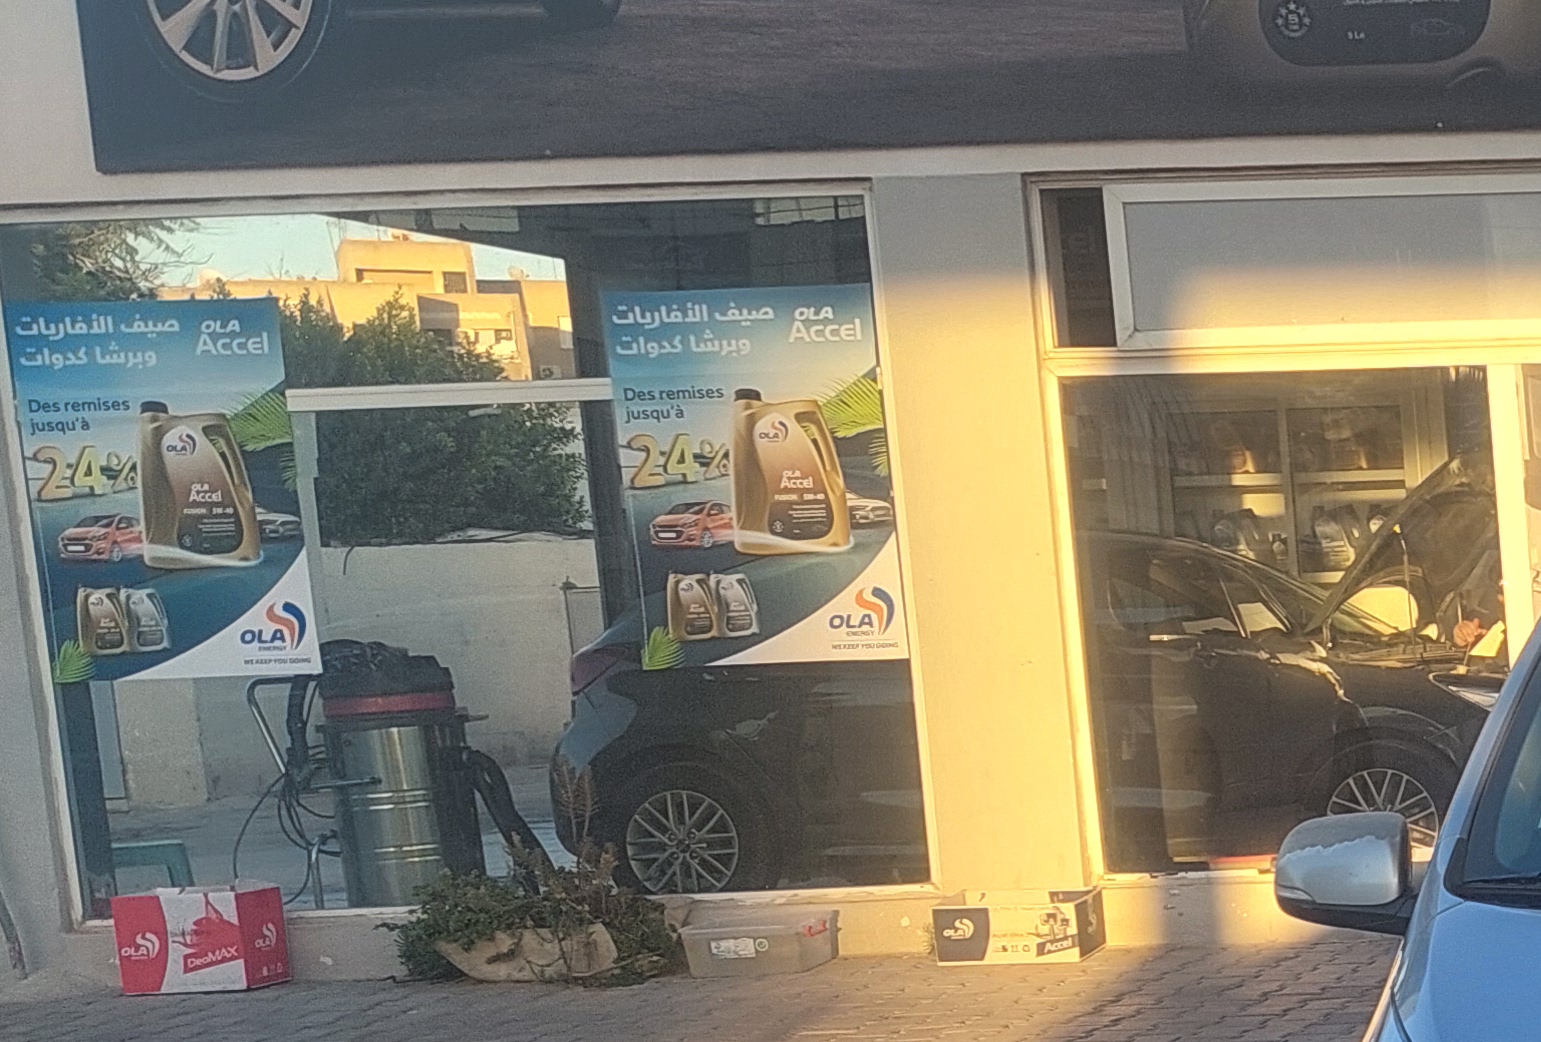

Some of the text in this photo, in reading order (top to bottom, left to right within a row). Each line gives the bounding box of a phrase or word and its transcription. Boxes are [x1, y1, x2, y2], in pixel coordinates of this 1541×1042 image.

[795, 307, 834, 320] OLA
[201, 320, 240, 333] OLA
[789, 318, 863, 343] Accel
[195, 331, 269, 356] Accel
[624, 385, 725, 402] Des remises
[28, 397, 131, 414] Des remises
[759, 432, 780, 440] OLA
[166, 444, 188, 453] OLA
[626, 432, 731, 489] 24%
[32, 444, 139, 501] 24%
[783, 470, 801, 478] OLA
[780, 476, 814, 489] Accel
[189, 489, 222, 502] Accel
[829, 614, 874, 629] OLA
[240, 629, 286, 645] OLA
[121, 946, 148, 957] OLA
[1044, 937, 1072, 953] Accel
